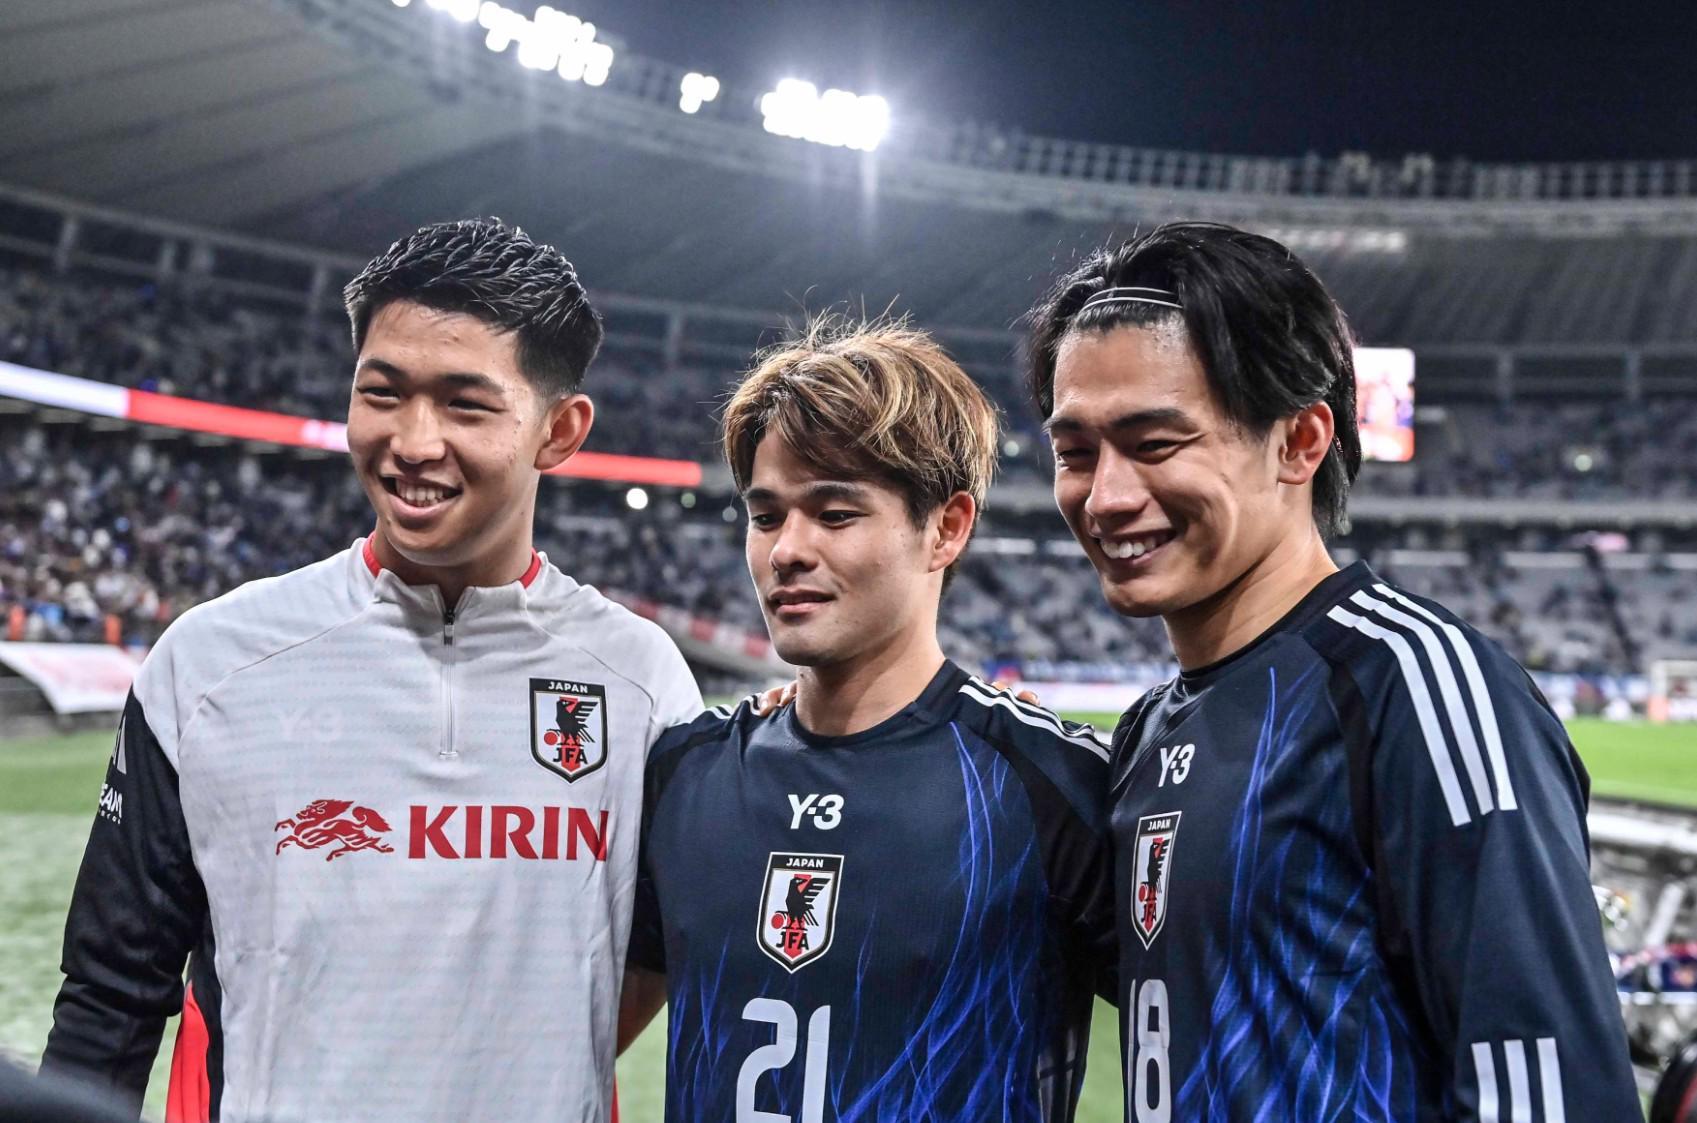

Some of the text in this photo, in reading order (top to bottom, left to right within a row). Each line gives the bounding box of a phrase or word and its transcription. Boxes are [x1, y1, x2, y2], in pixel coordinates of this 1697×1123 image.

[548, 681, 588, 693] JAPAN
[553, 747, 588, 765] JFA
[1158, 743, 1195, 788] Y-3
[787, 793, 844, 830] Y-3
[408, 805, 609, 862] KIRIN
[1147, 818, 1171, 831] JAPAN
[786, 857, 824, 868] JAPAN
[1141, 902, 1157, 922] JFA
[775, 931, 810, 951] JFA
[736, 997, 831, 1123] 21
[1128, 978, 1172, 1123] 18
